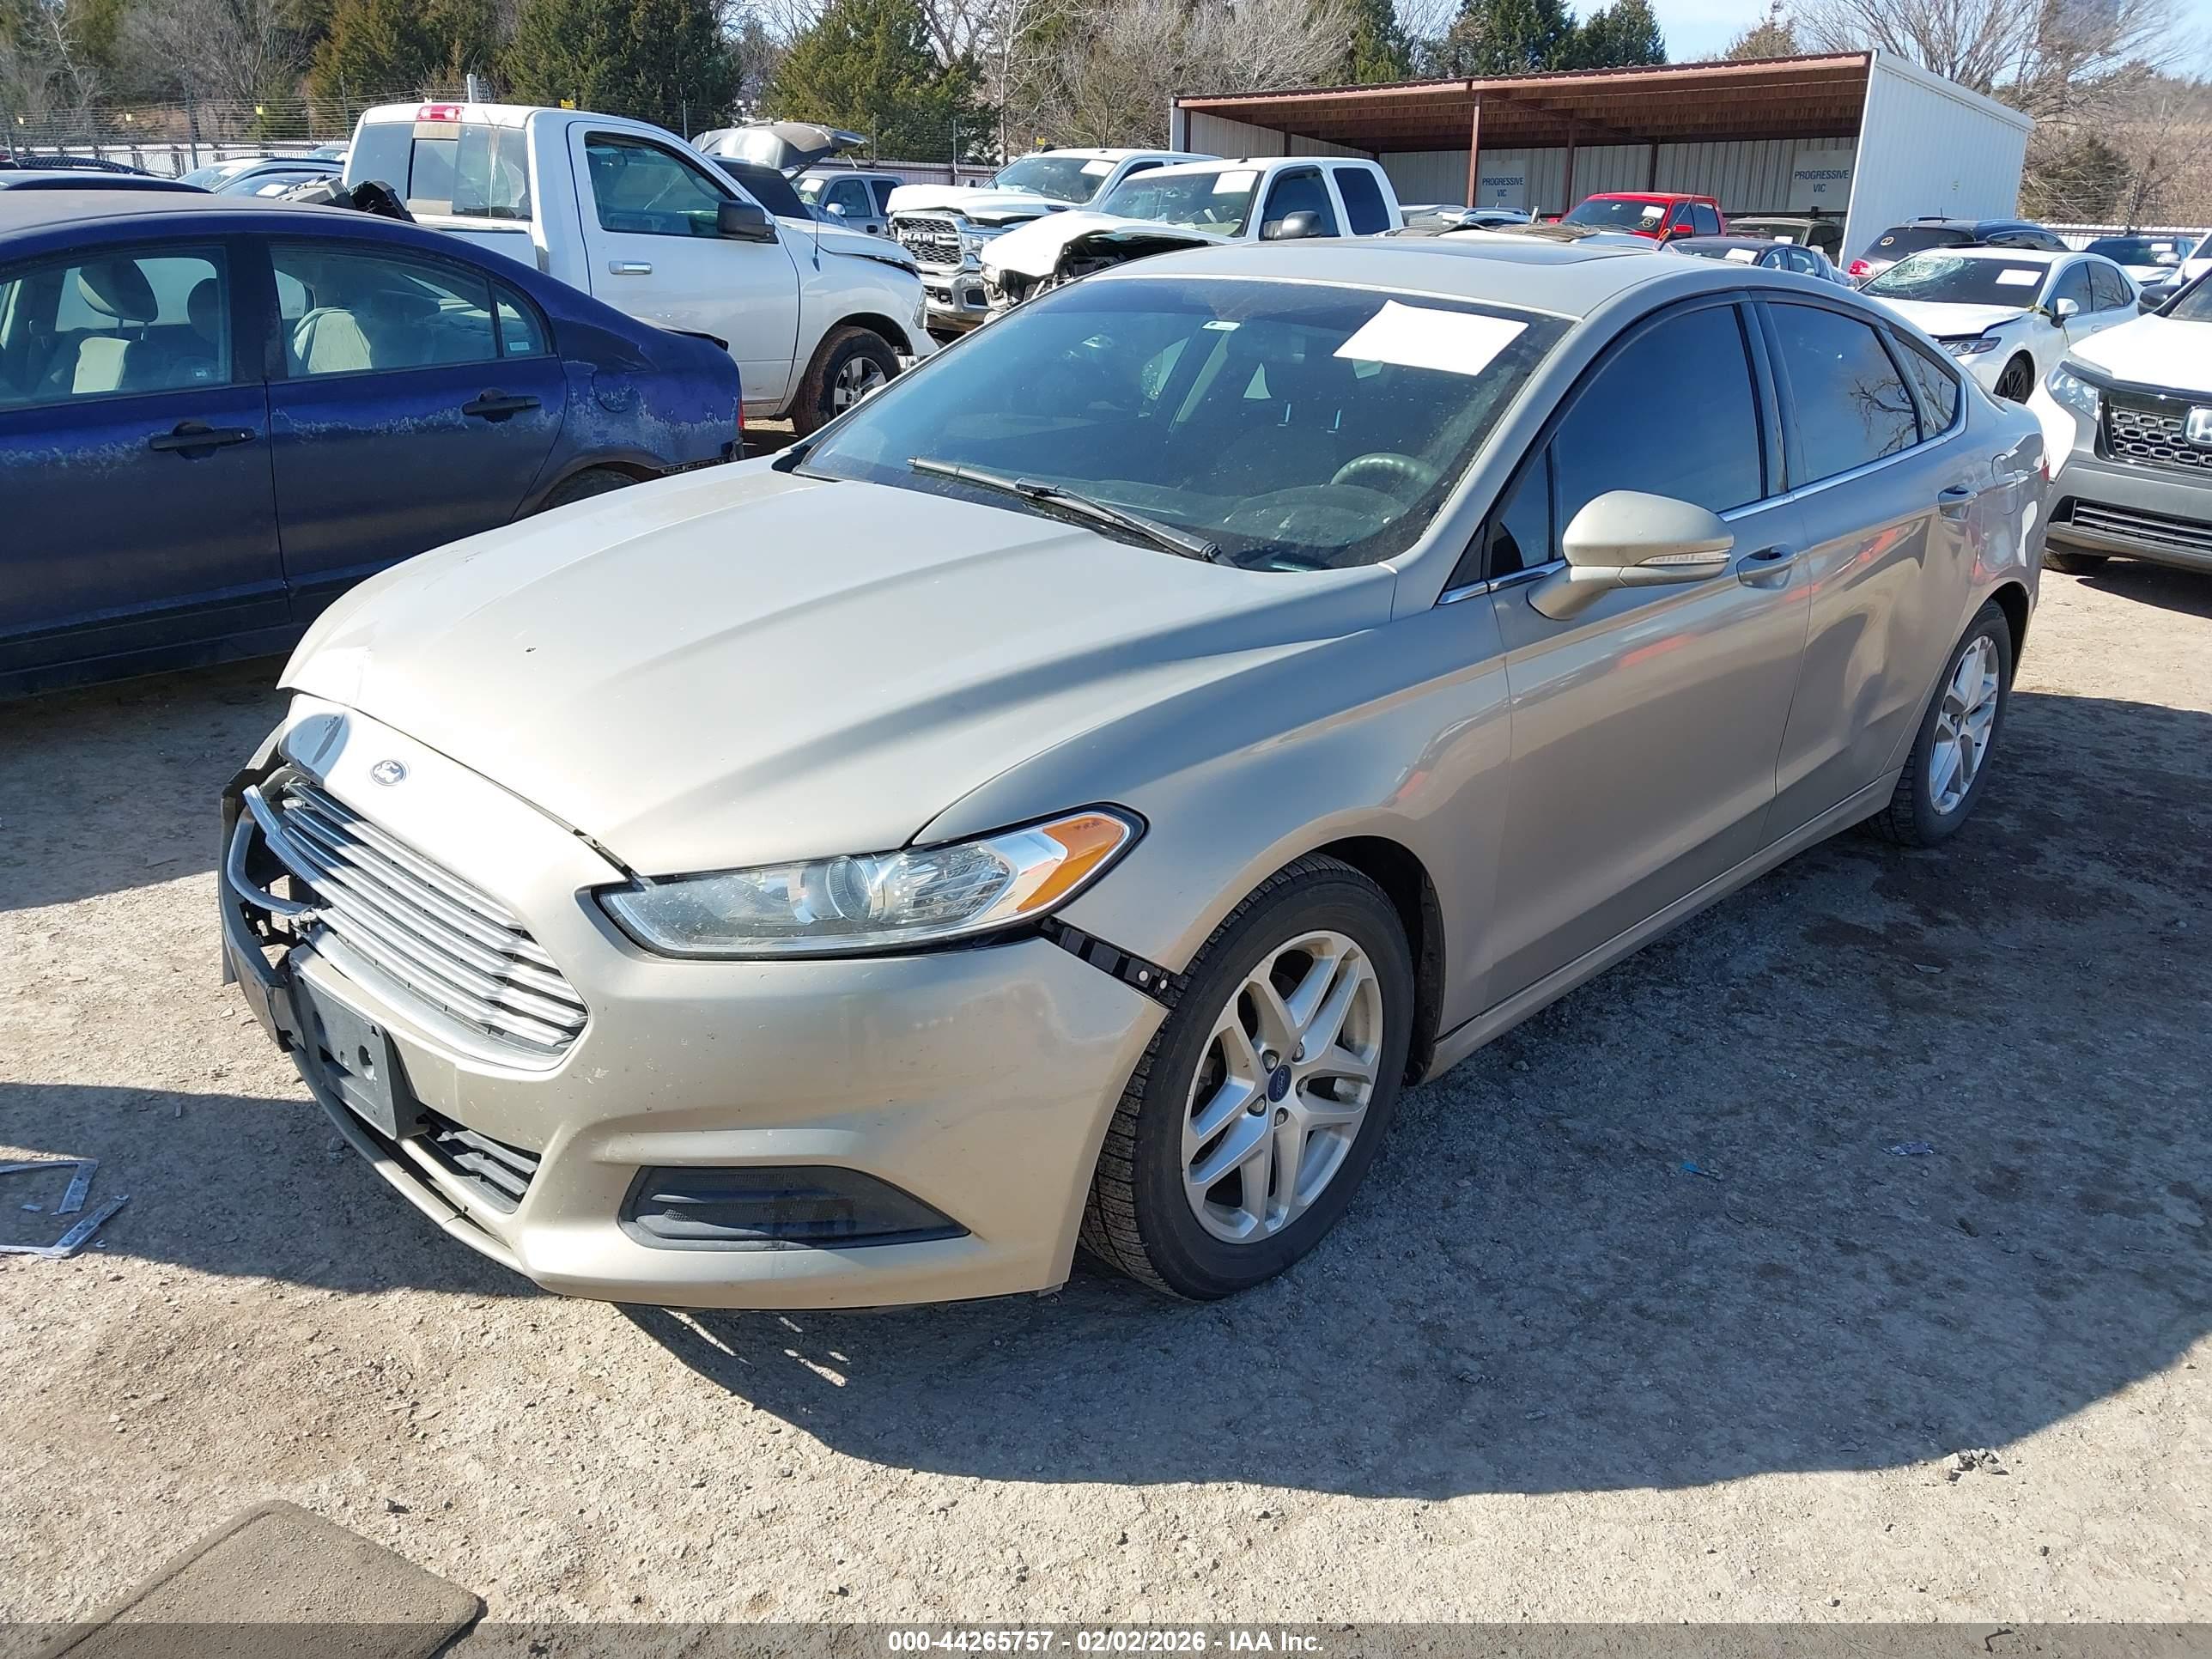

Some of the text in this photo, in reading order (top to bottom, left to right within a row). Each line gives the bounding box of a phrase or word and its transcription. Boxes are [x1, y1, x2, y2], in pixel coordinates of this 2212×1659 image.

[1794, 170, 1849, 179] PROGRESSIVE
[1482, 177, 1524, 185] PROGRESSIVE
[1813, 183, 1826, 192] VIC
[902, 232, 934, 242] RAM
